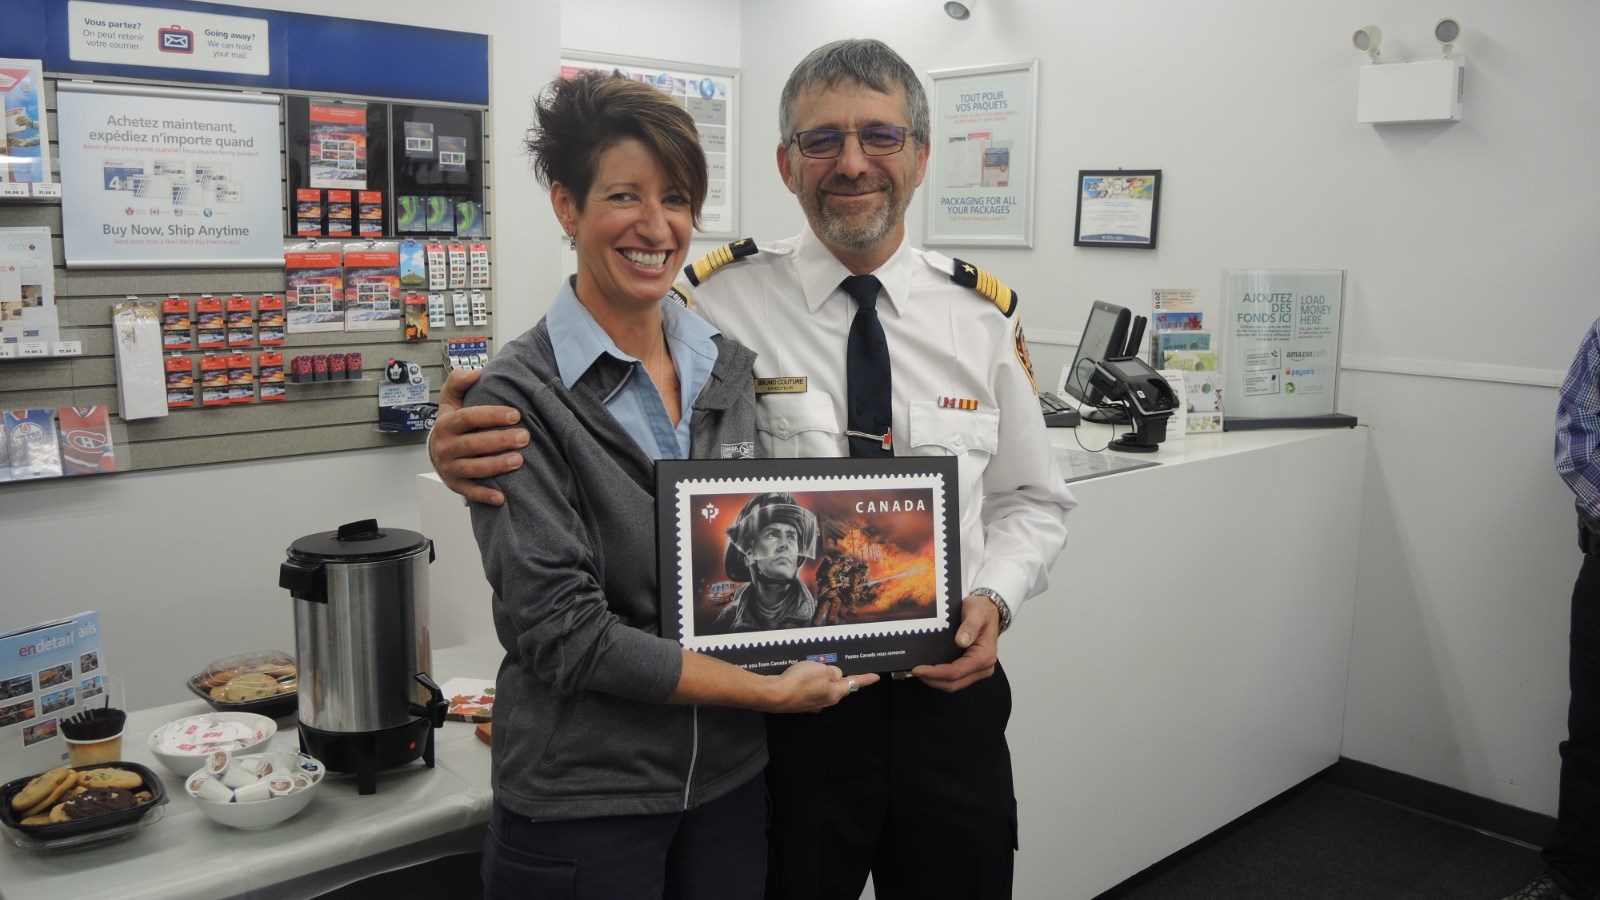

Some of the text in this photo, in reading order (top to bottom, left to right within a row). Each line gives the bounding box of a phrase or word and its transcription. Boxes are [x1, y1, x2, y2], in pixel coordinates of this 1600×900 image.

[84, 18, 142, 29] Vous partez?
[82, 29, 95, 37] On
[97, 31, 116, 39] peut
[204, 29, 256, 41] Going away?
[109, 42, 141, 50] courrier.
[236, 43, 251, 51] hold
[960, 91, 1004, 103] TOUT POUR
[956, 99, 1008, 112] VOS PAQUETS
[107, 115, 236, 133] Achetez maintenant,
[89, 130, 254, 149] expédiez n'importe quand
[941, 196, 1017, 206] PACKAGING FOR ALL
[947, 205, 1010, 214] YOUR PACKAGES
[103, 224, 249, 238] Buy Now, Ship Anytime
[1242, 293, 1292, 303] AJOUTEZ
[1301, 295, 1325, 305] LOAD
[1271, 303, 1292, 313] DES
[1300, 305, 1332, 315] MONEY
[1237, 313, 1291, 323] FONDS ICI
[1300, 315, 1322, 325] HERE
[855, 499, 925, 513] CANADA
[78, 622, 96, 638] ails
[19, 631, 74, 657] endétail
